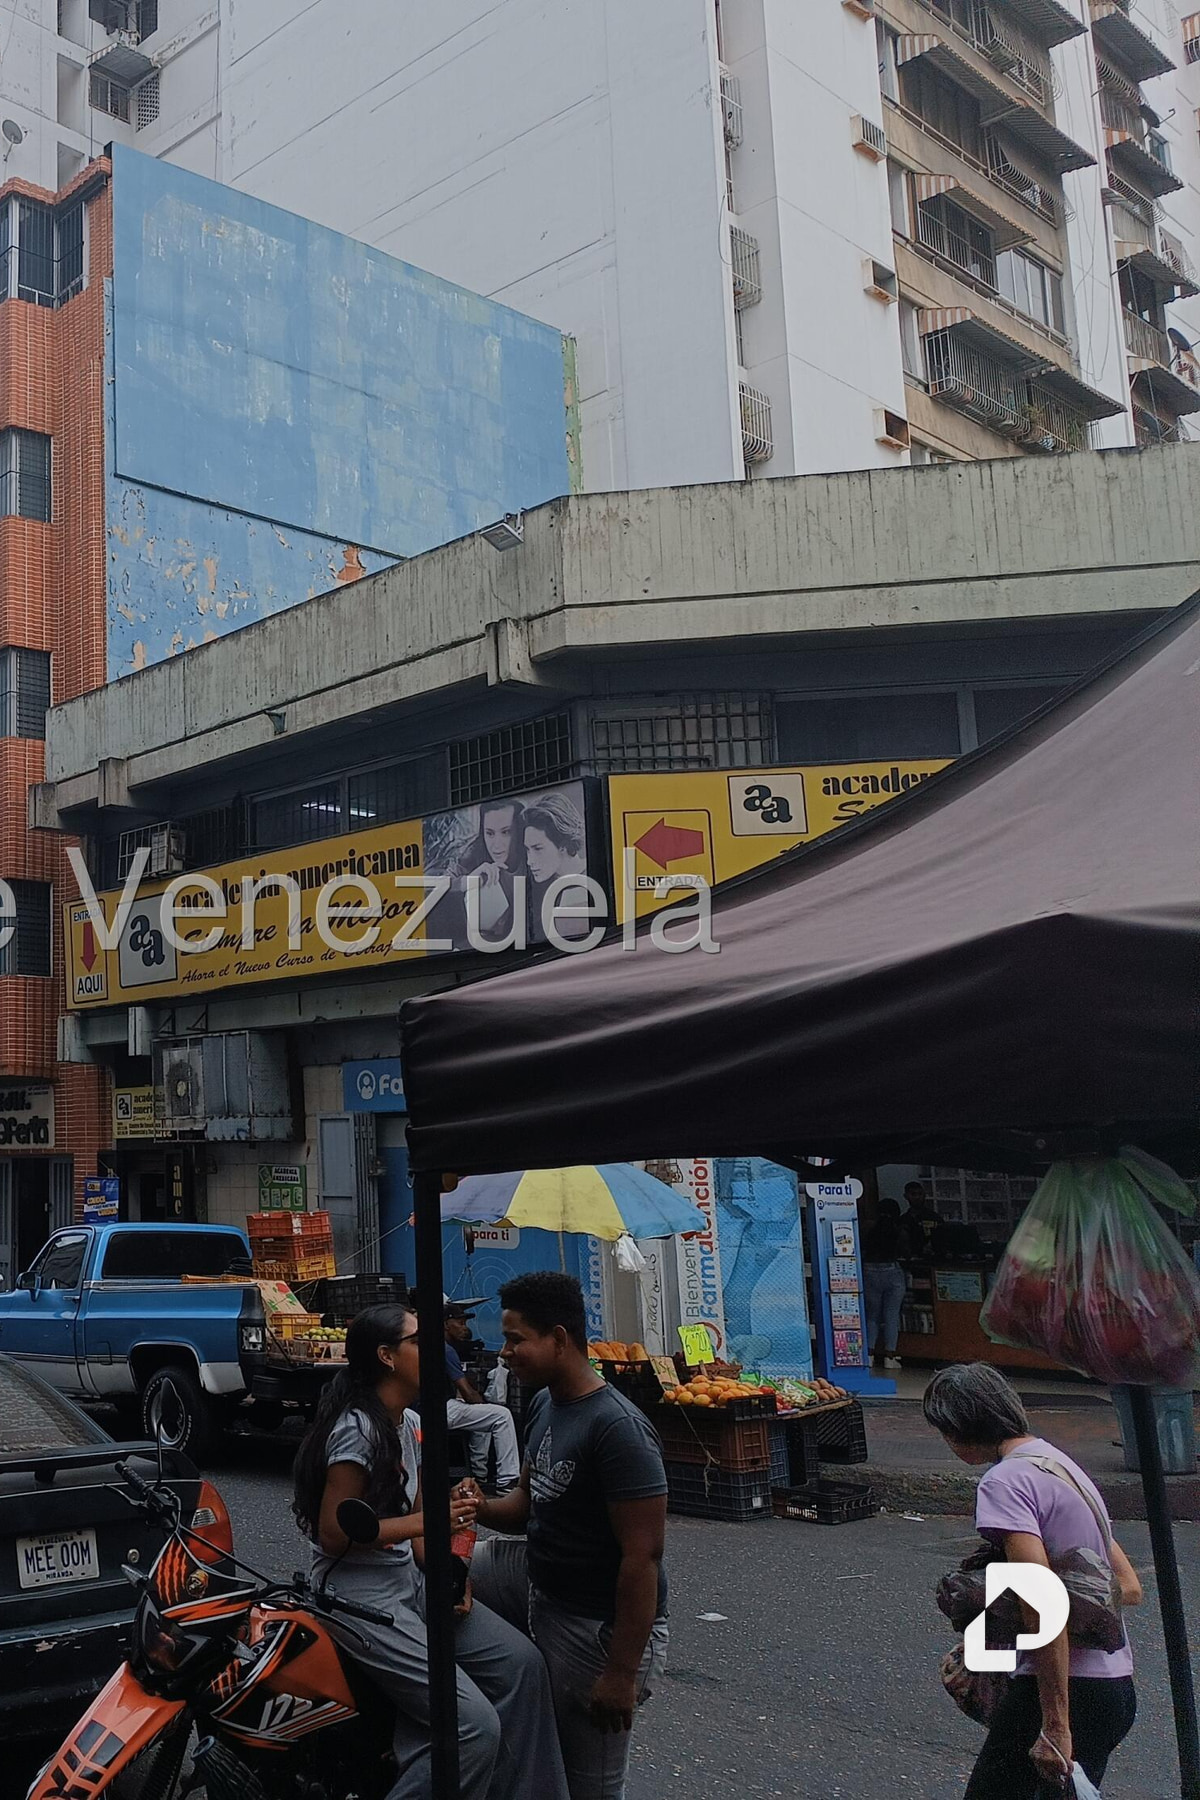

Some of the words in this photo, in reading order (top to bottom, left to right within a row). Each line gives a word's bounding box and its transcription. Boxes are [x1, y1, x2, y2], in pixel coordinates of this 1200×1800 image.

[822, 767, 936, 796] acade
[286, 843, 420, 892] americana
[638, 876, 704, 887] ENTRADA
[180, 968, 215, 985] Ahora
[218, 965, 230, 977] el
[234, 961, 271, 976] Nuevo
[275, 952, 315, 967] Curso
[320, 948, 337, 961] de
[77, 974, 103, 995] AQUI
[818, 1184, 843, 1196] Para
[844, 1184, 853, 1196] ti
[501, 1228, 510, 1241] ti
[24, 1544, 56, 1574] MEE
